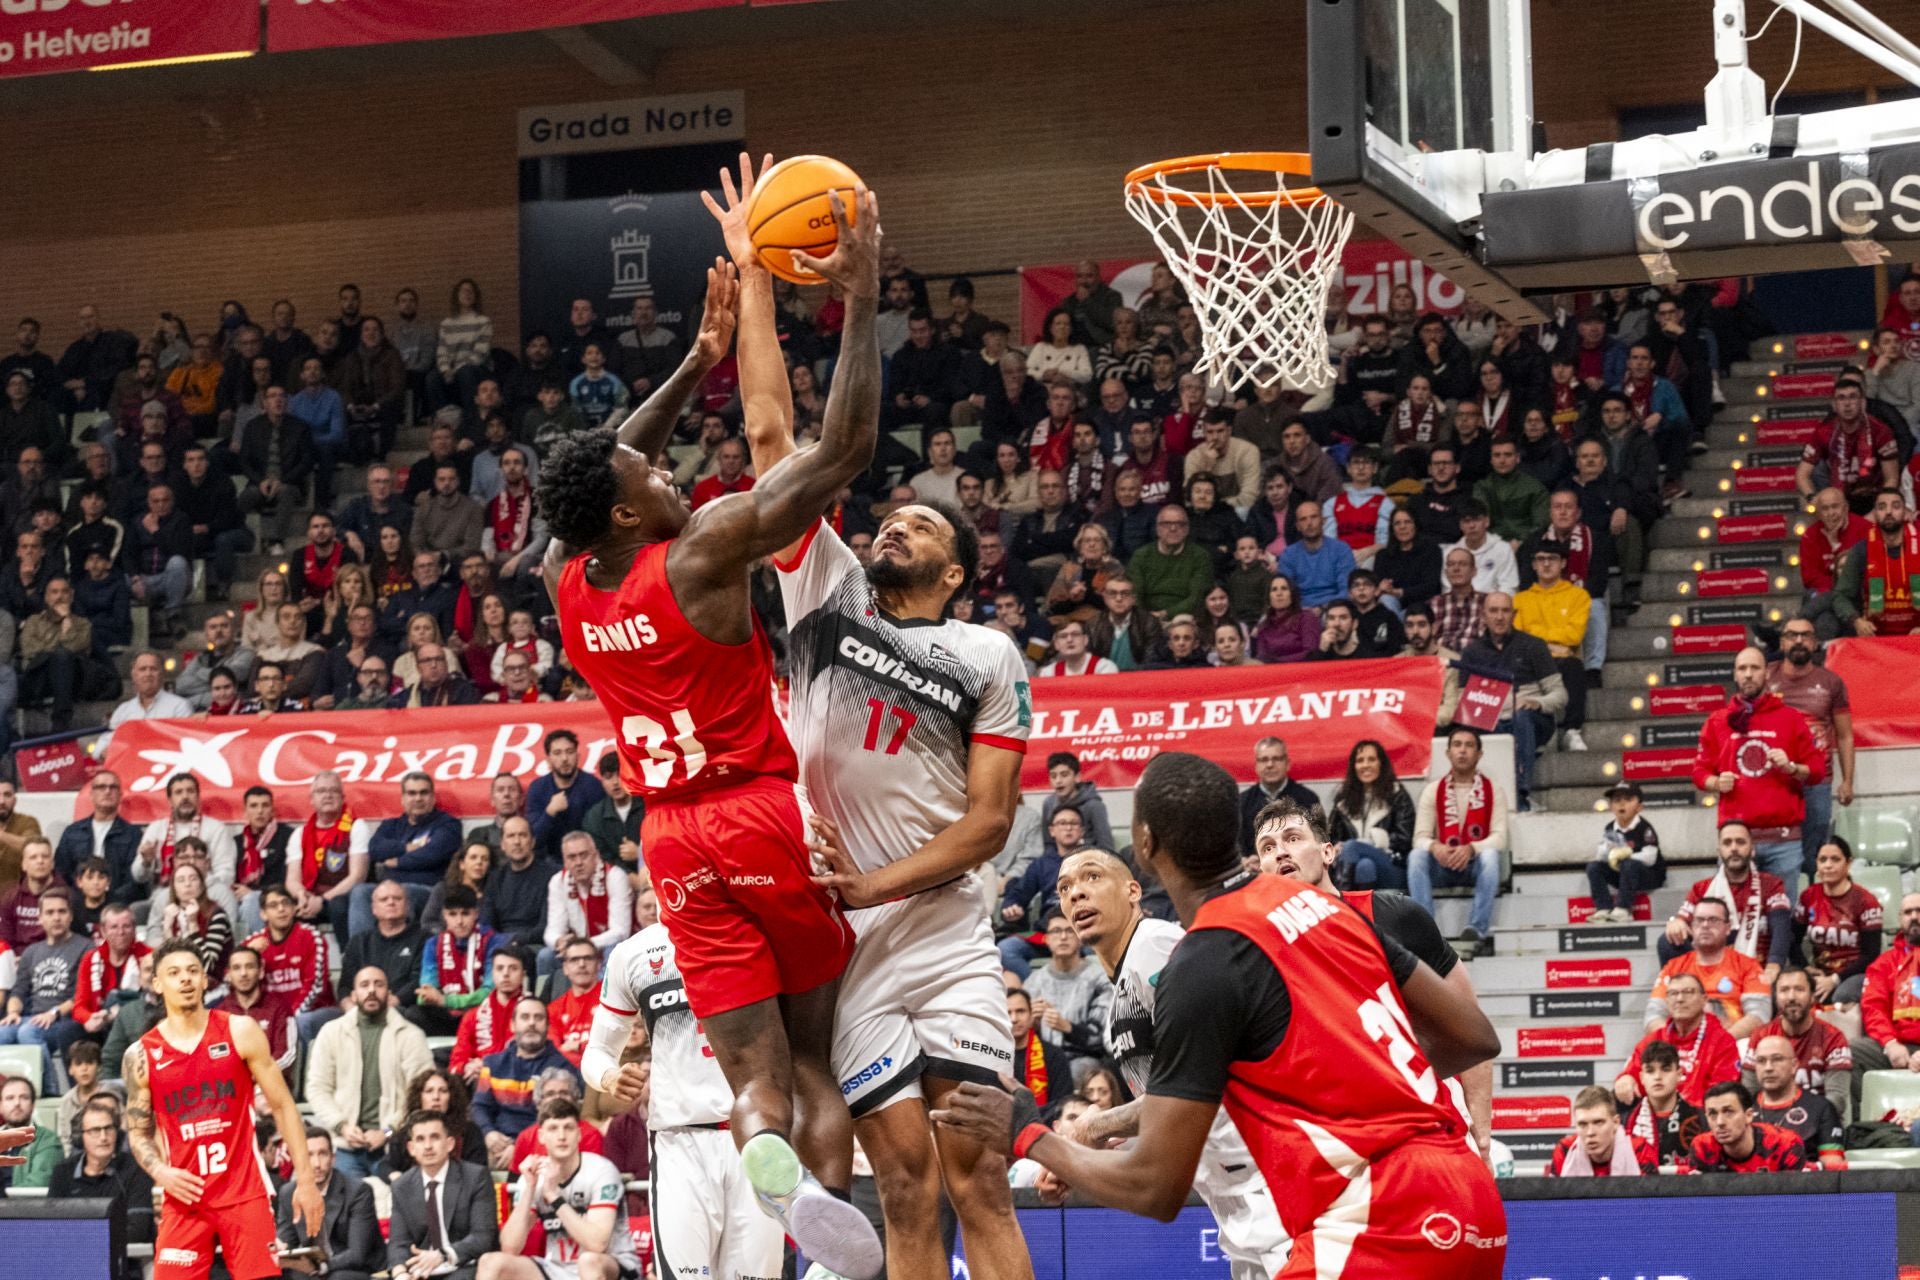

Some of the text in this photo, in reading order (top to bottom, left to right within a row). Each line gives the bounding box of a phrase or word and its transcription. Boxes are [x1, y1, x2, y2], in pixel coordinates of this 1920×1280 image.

[23, 21, 151, 60] Helvetia
[528, 104, 733, 143] Grada Norte
[581, 613, 658, 652] ENNIS
[863, 697, 918, 756] 17
[1131, 711, 1164, 729] DE
[1168, 688, 1406, 731] LEVANTE
[621, 708, 708, 789] 31
[1071, 731, 1187, 746] MURCIA 1963
[729, 875, 775, 886] MURCIA
[646, 945, 668, 954] vive
[960, 1039, 1012, 1063] BERNER
[163, 1078, 236, 1114] UCAM
[840, 1060, 883, 1097] asisa
[197, 1142, 228, 1176] 12
[679, 1266, 699, 1274] vive
